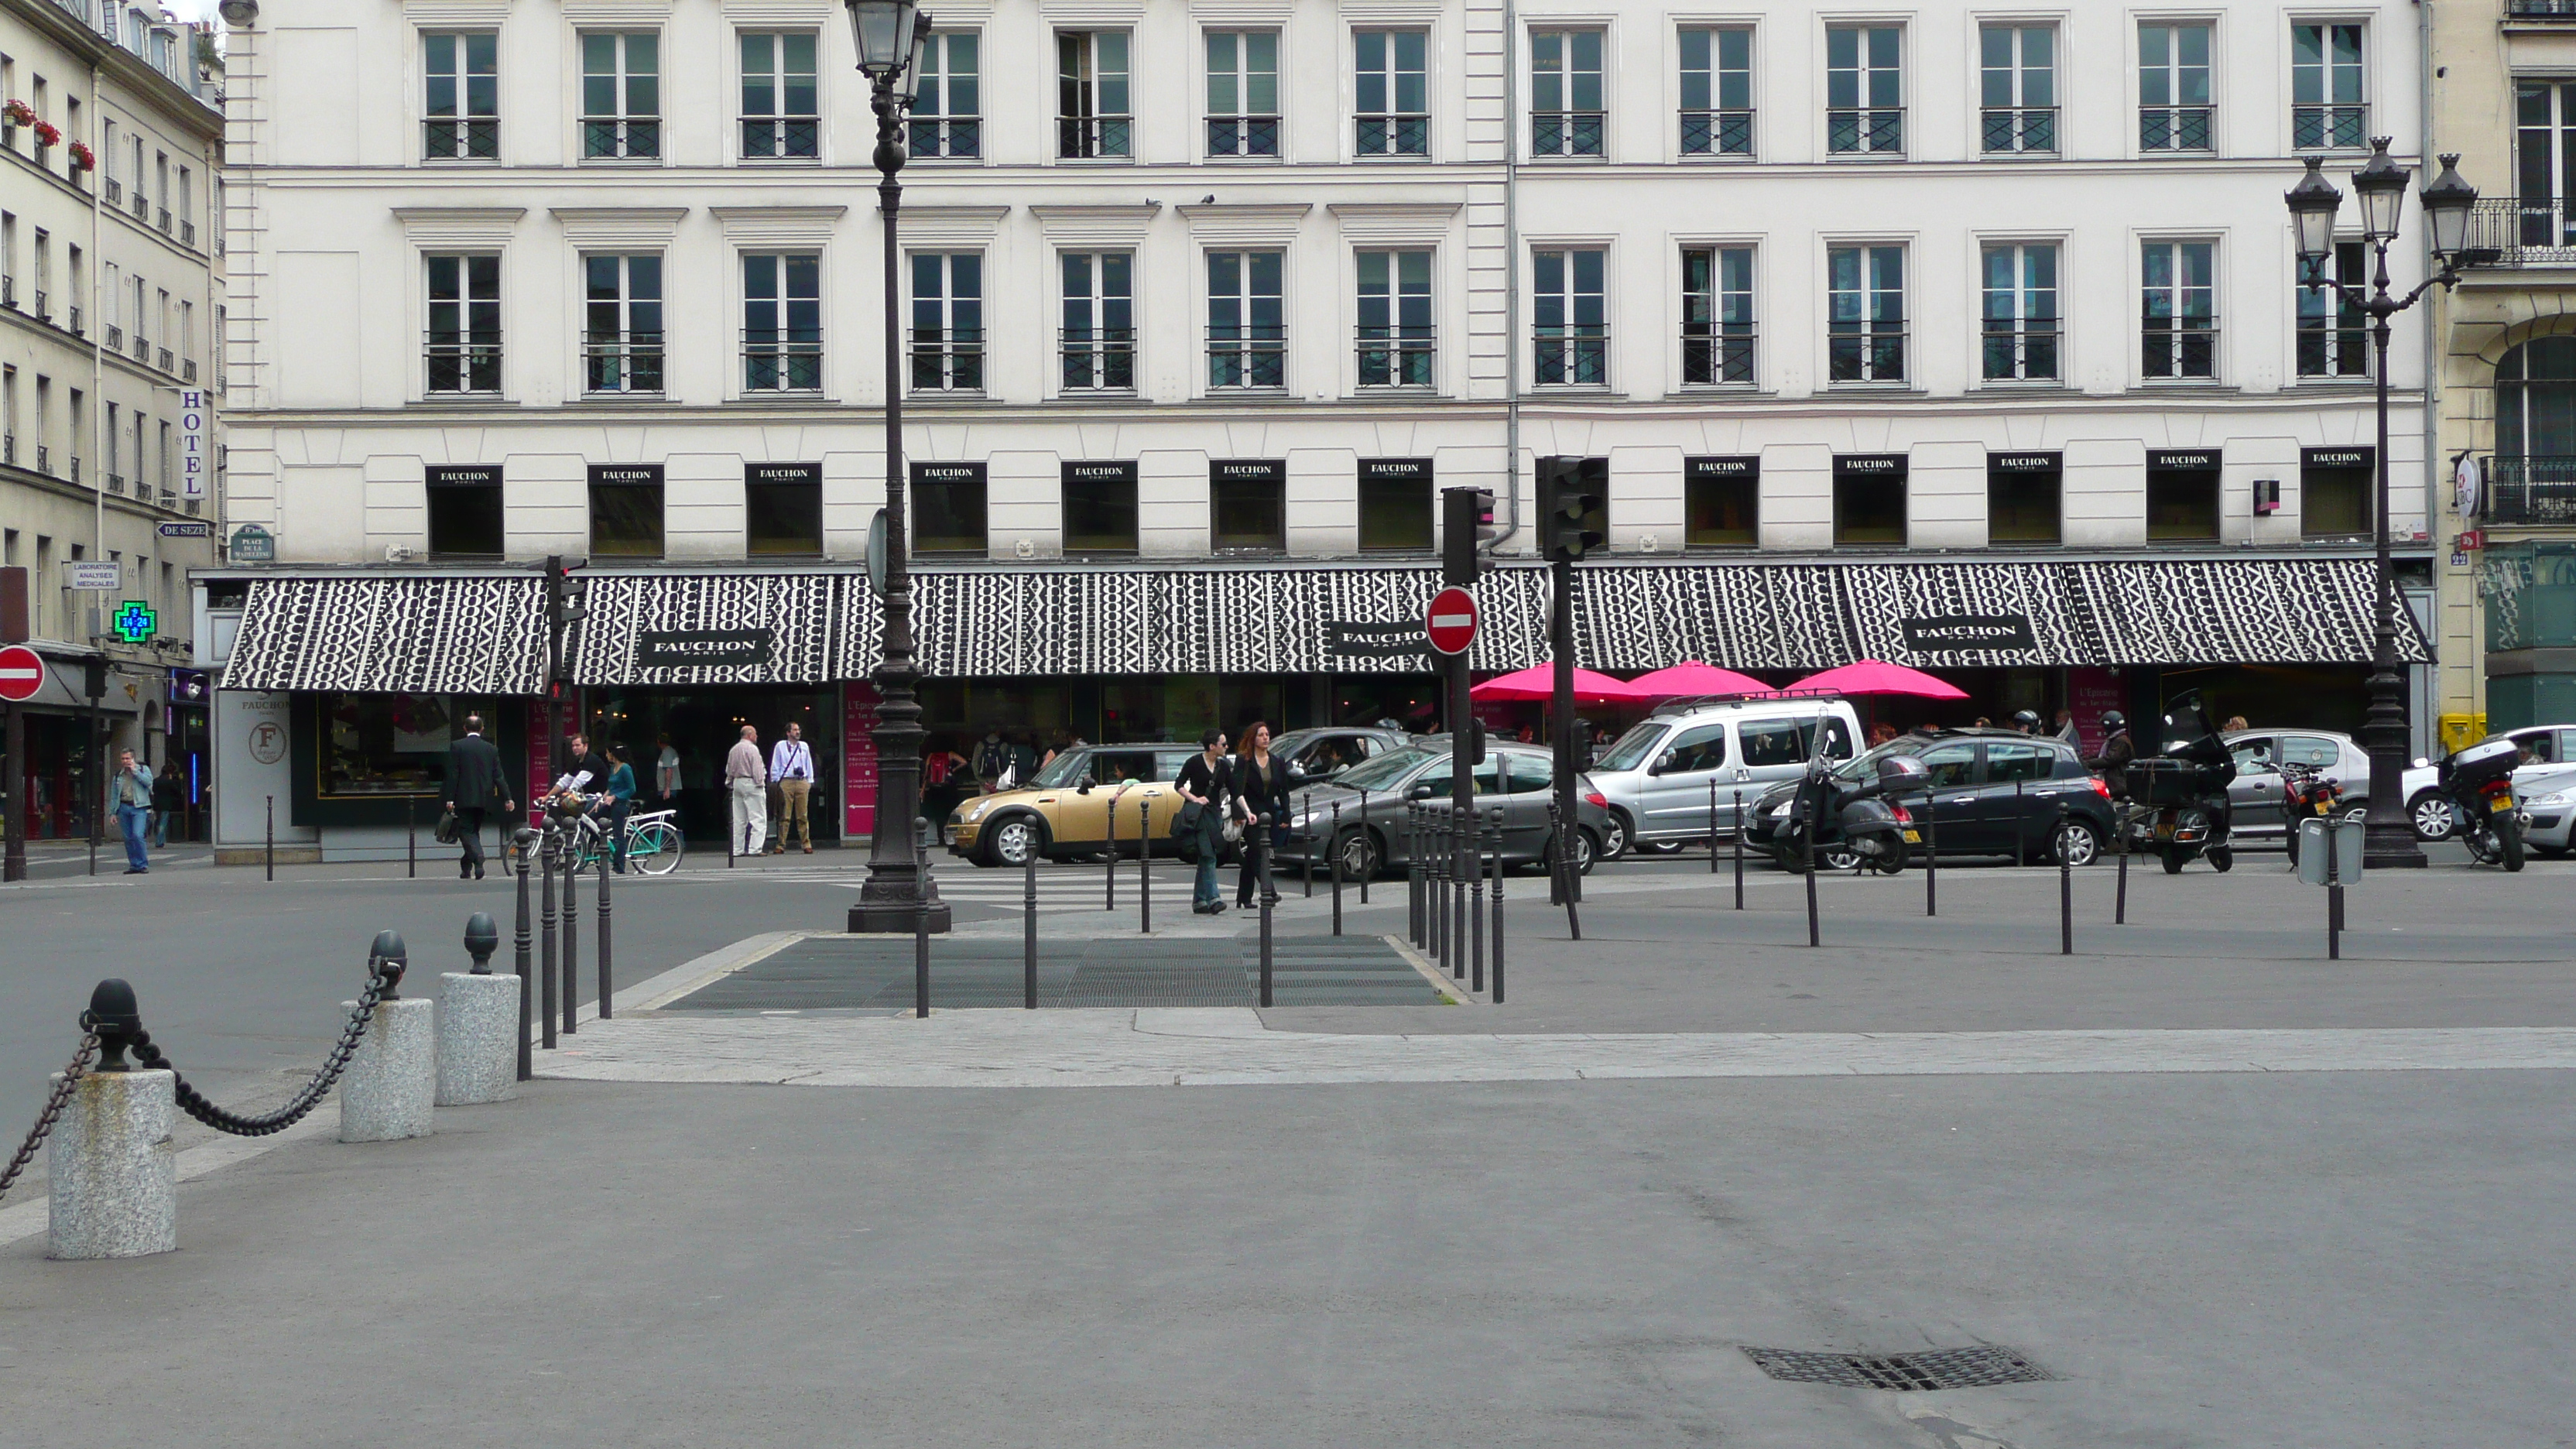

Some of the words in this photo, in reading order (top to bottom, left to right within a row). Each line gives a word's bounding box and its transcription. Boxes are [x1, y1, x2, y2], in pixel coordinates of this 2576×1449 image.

[182, 392, 201, 495] HOTEL
[2001, 458, 2048, 466] FAUCHON
[2161, 456, 2208, 464] FAUCHON
[2314, 454, 2361, 462] FAUCHON
[1372, 464, 1418, 473] FAUCHON
[1699, 462, 1745, 471] FAUCHON
[1847, 460, 1894, 469] FAUCHON
[603, 471, 651, 479] FAUCHON
[925, 468, 973, 477] FAUCHON
[1076, 467, 1123, 475] FAUCHON
[441, 472, 489, 480] FAUCHON
[165, 526, 179, 535] DE
[180, 526, 205, 535] SEZE
[2452, 555, 2467, 565] 22
[1916, 625, 2016, 638] FAUCHON
[1342, 631, 1428, 643] FAUCHO
[653, 640, 756, 652] FAUCHON
